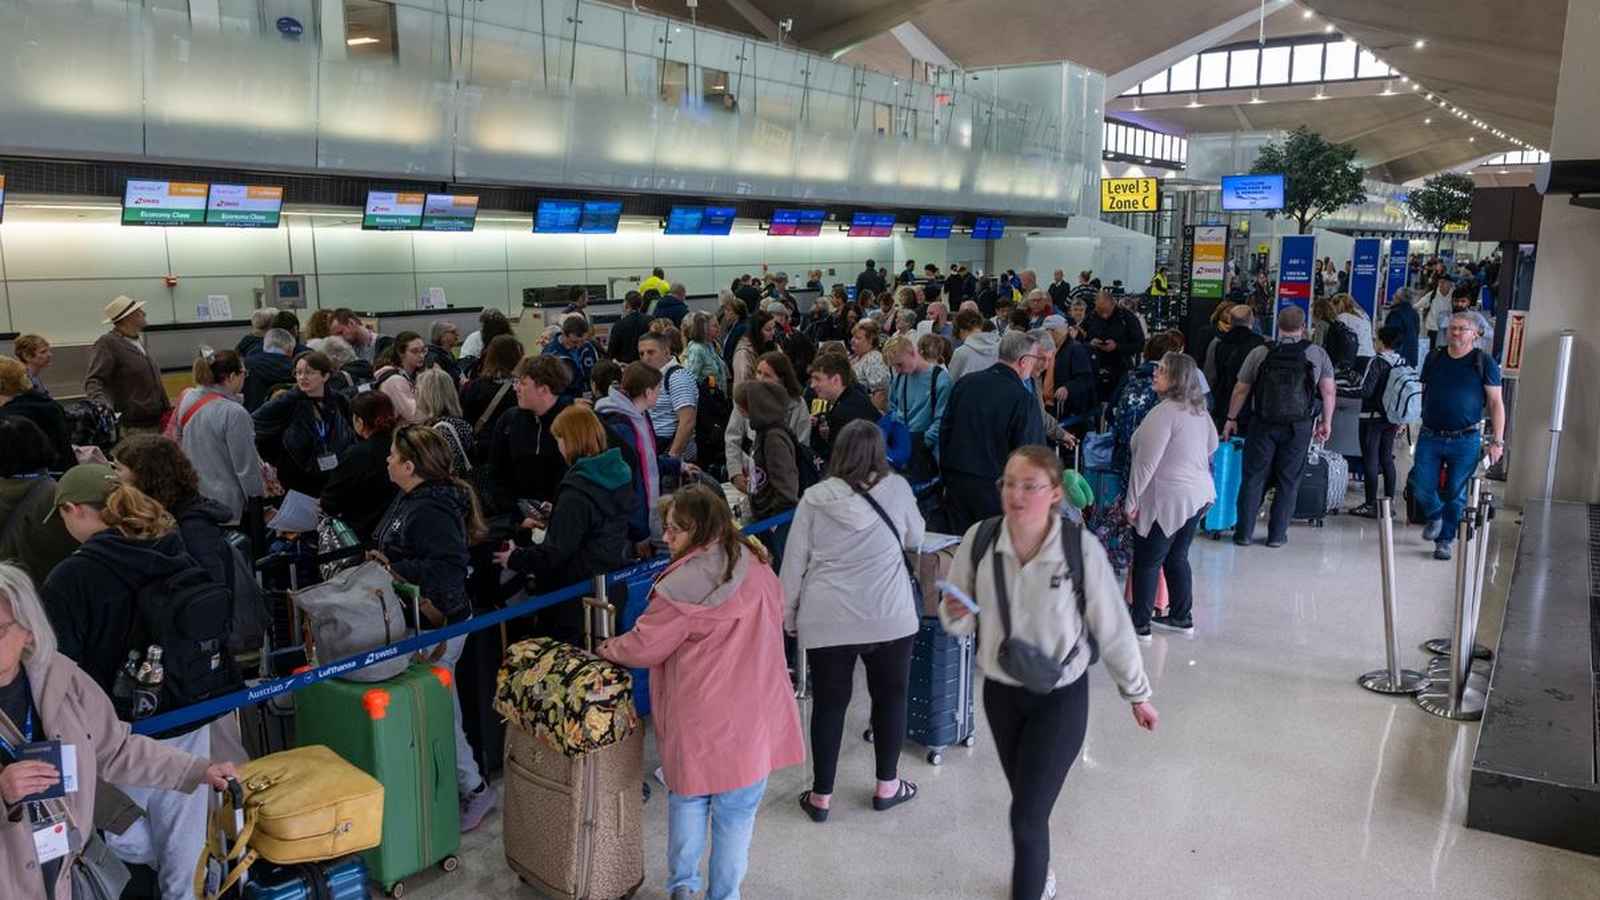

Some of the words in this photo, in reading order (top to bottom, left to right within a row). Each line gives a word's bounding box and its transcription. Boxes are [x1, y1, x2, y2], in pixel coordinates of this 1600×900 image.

[1107, 180, 1140, 194] Level
[1142, 180, 1150, 193] 3
[1109, 196, 1139, 209] Zone
[1142, 196, 1150, 209] C
[140, 211, 171, 219] Economy
[172, 211, 190, 219] Class
[248, 683, 284, 701] Austrian
[318, 661, 357, 678] Lufthansa
